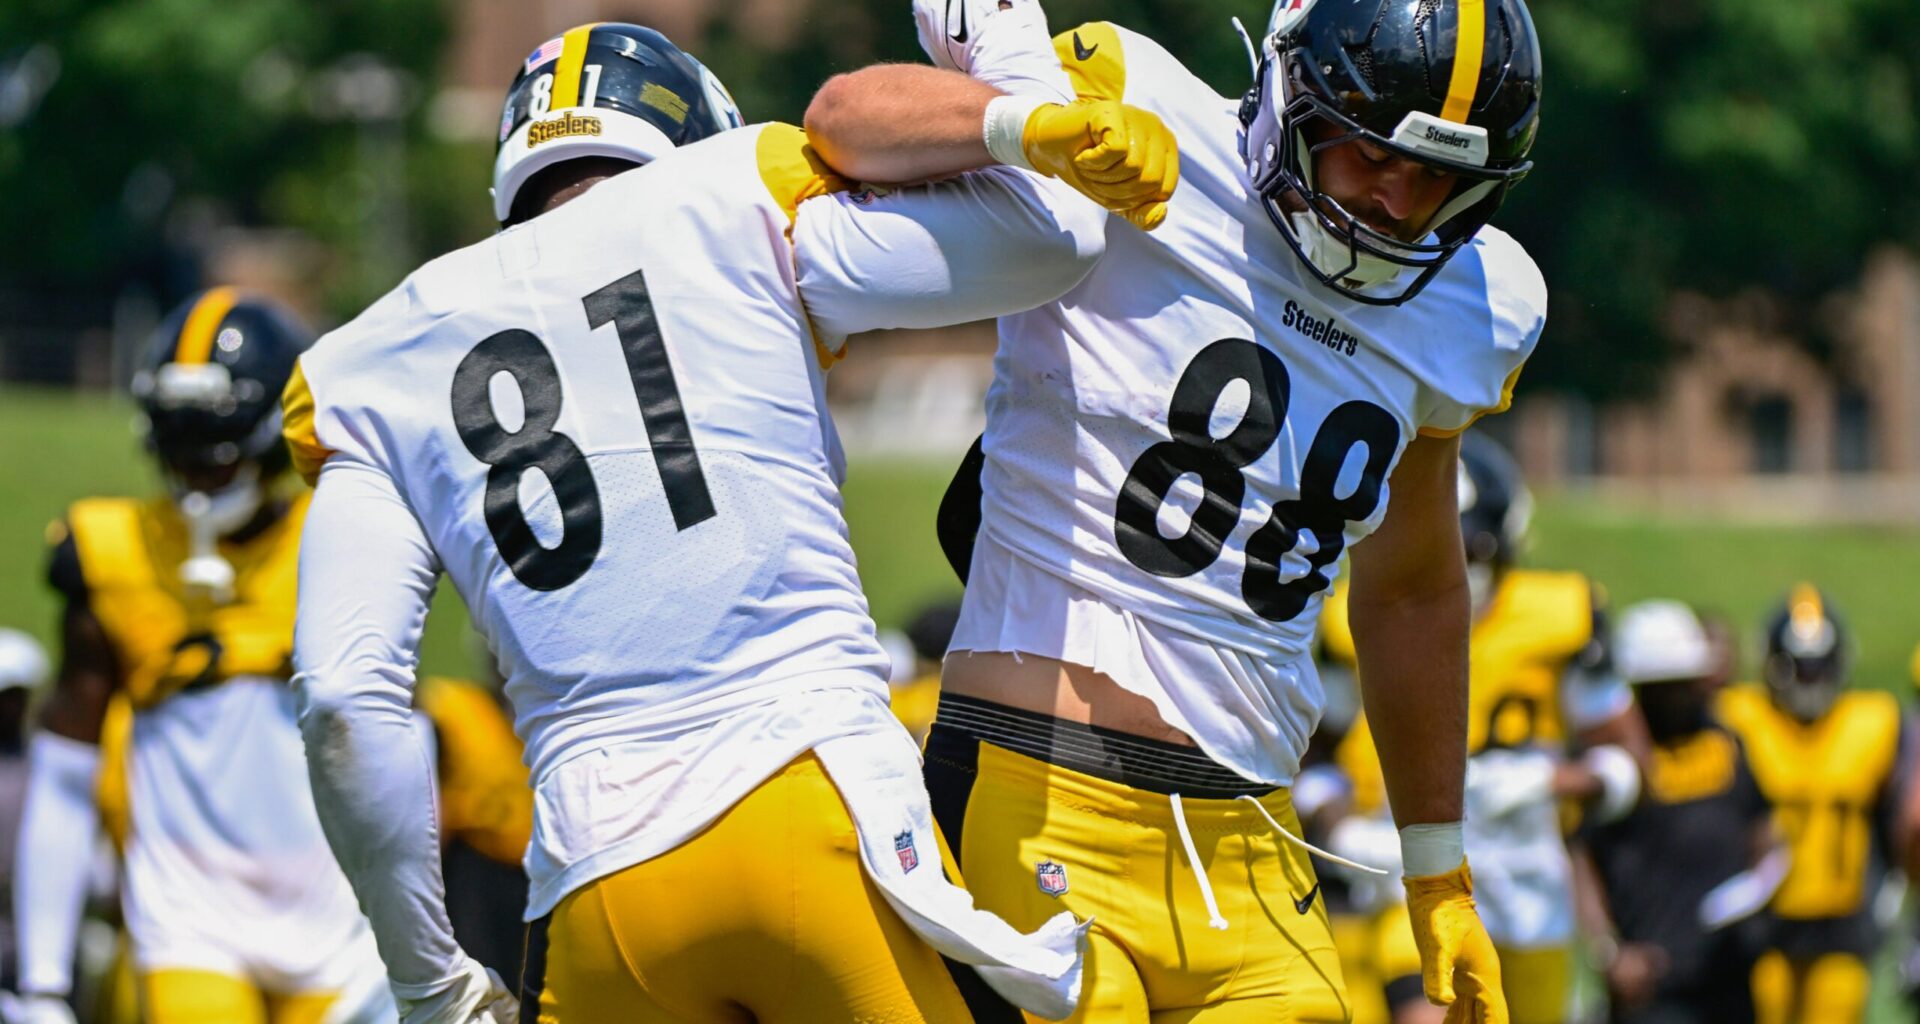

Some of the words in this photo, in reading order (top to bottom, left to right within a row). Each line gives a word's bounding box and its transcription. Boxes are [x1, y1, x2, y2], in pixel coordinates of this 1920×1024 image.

[527, 111, 603, 148] Steelers
[1425, 125, 1471, 149] Steelers
[1282, 299, 1358, 357] Steelers
[451, 269, 717, 591] 81
[1114, 338, 1400, 622] 88
